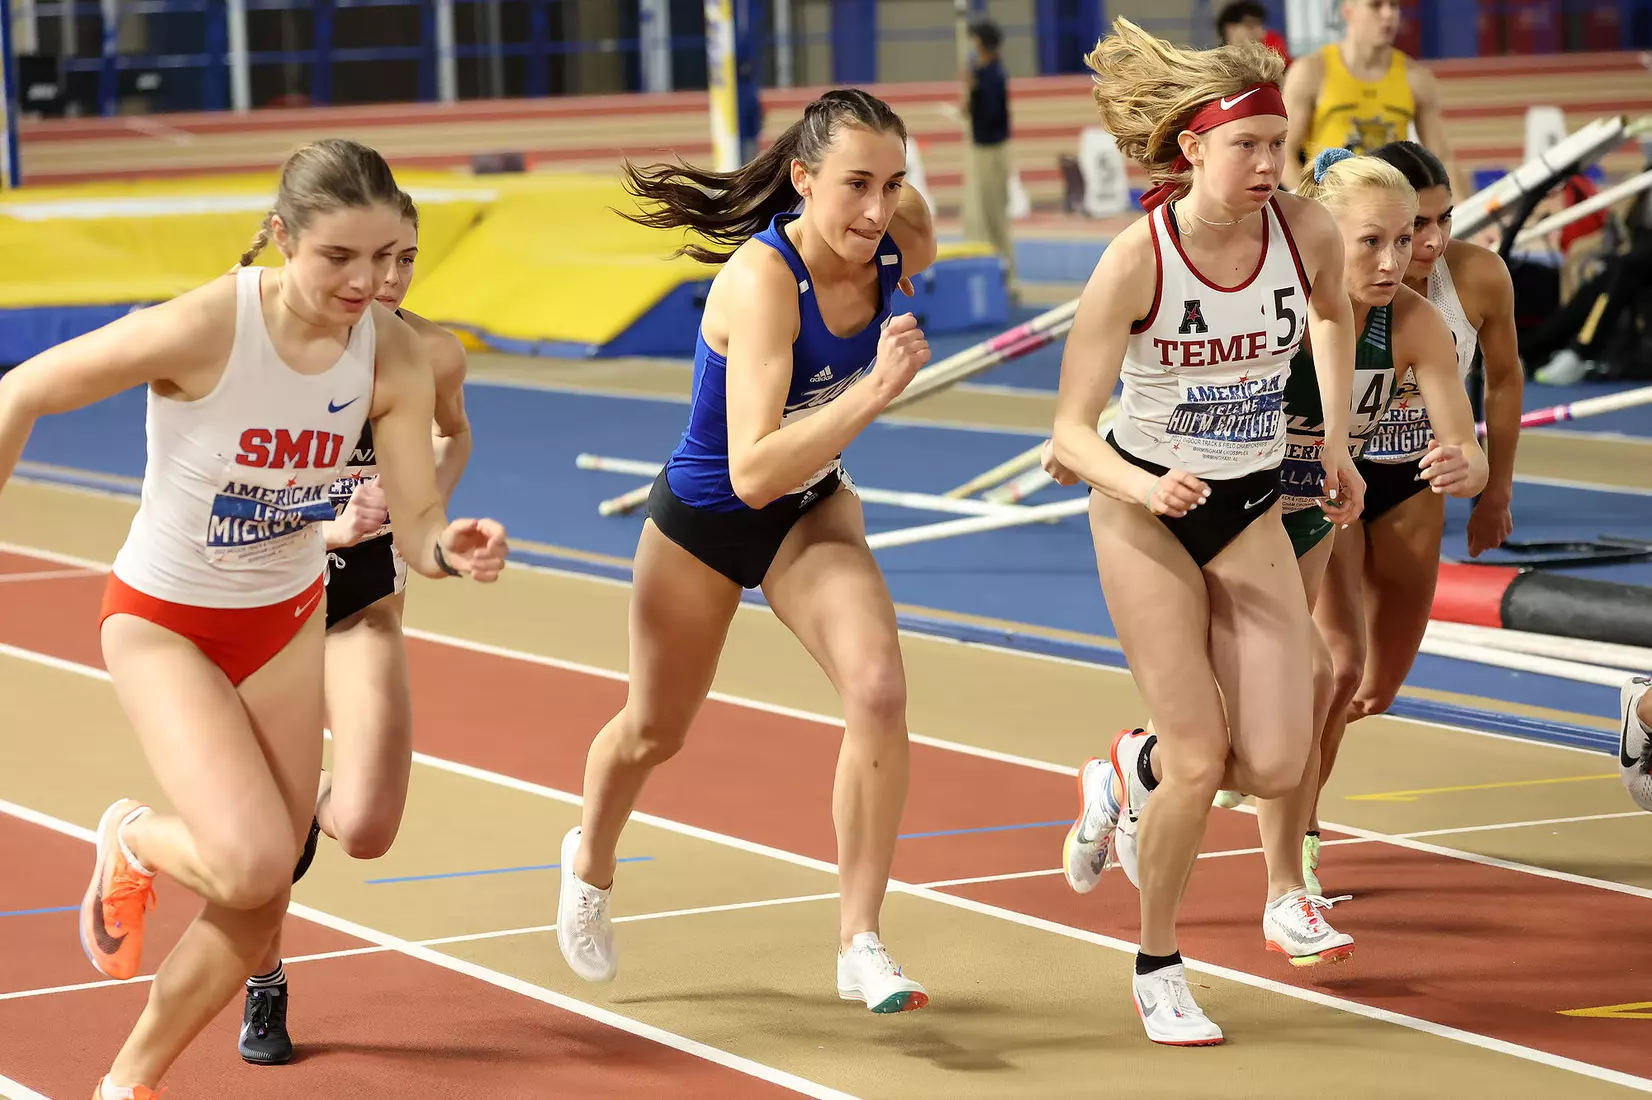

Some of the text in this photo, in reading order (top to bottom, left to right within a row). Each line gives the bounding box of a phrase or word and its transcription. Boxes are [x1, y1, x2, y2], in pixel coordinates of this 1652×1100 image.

[1274, 287, 1296, 346] 5
[1154, 331, 1300, 367] TEMP
[1187, 375, 1281, 402] AMERICAN
[1356, 374, 1382, 421] 4
[236, 428, 344, 469] SMU
[222, 480, 325, 507] AMERICAN
